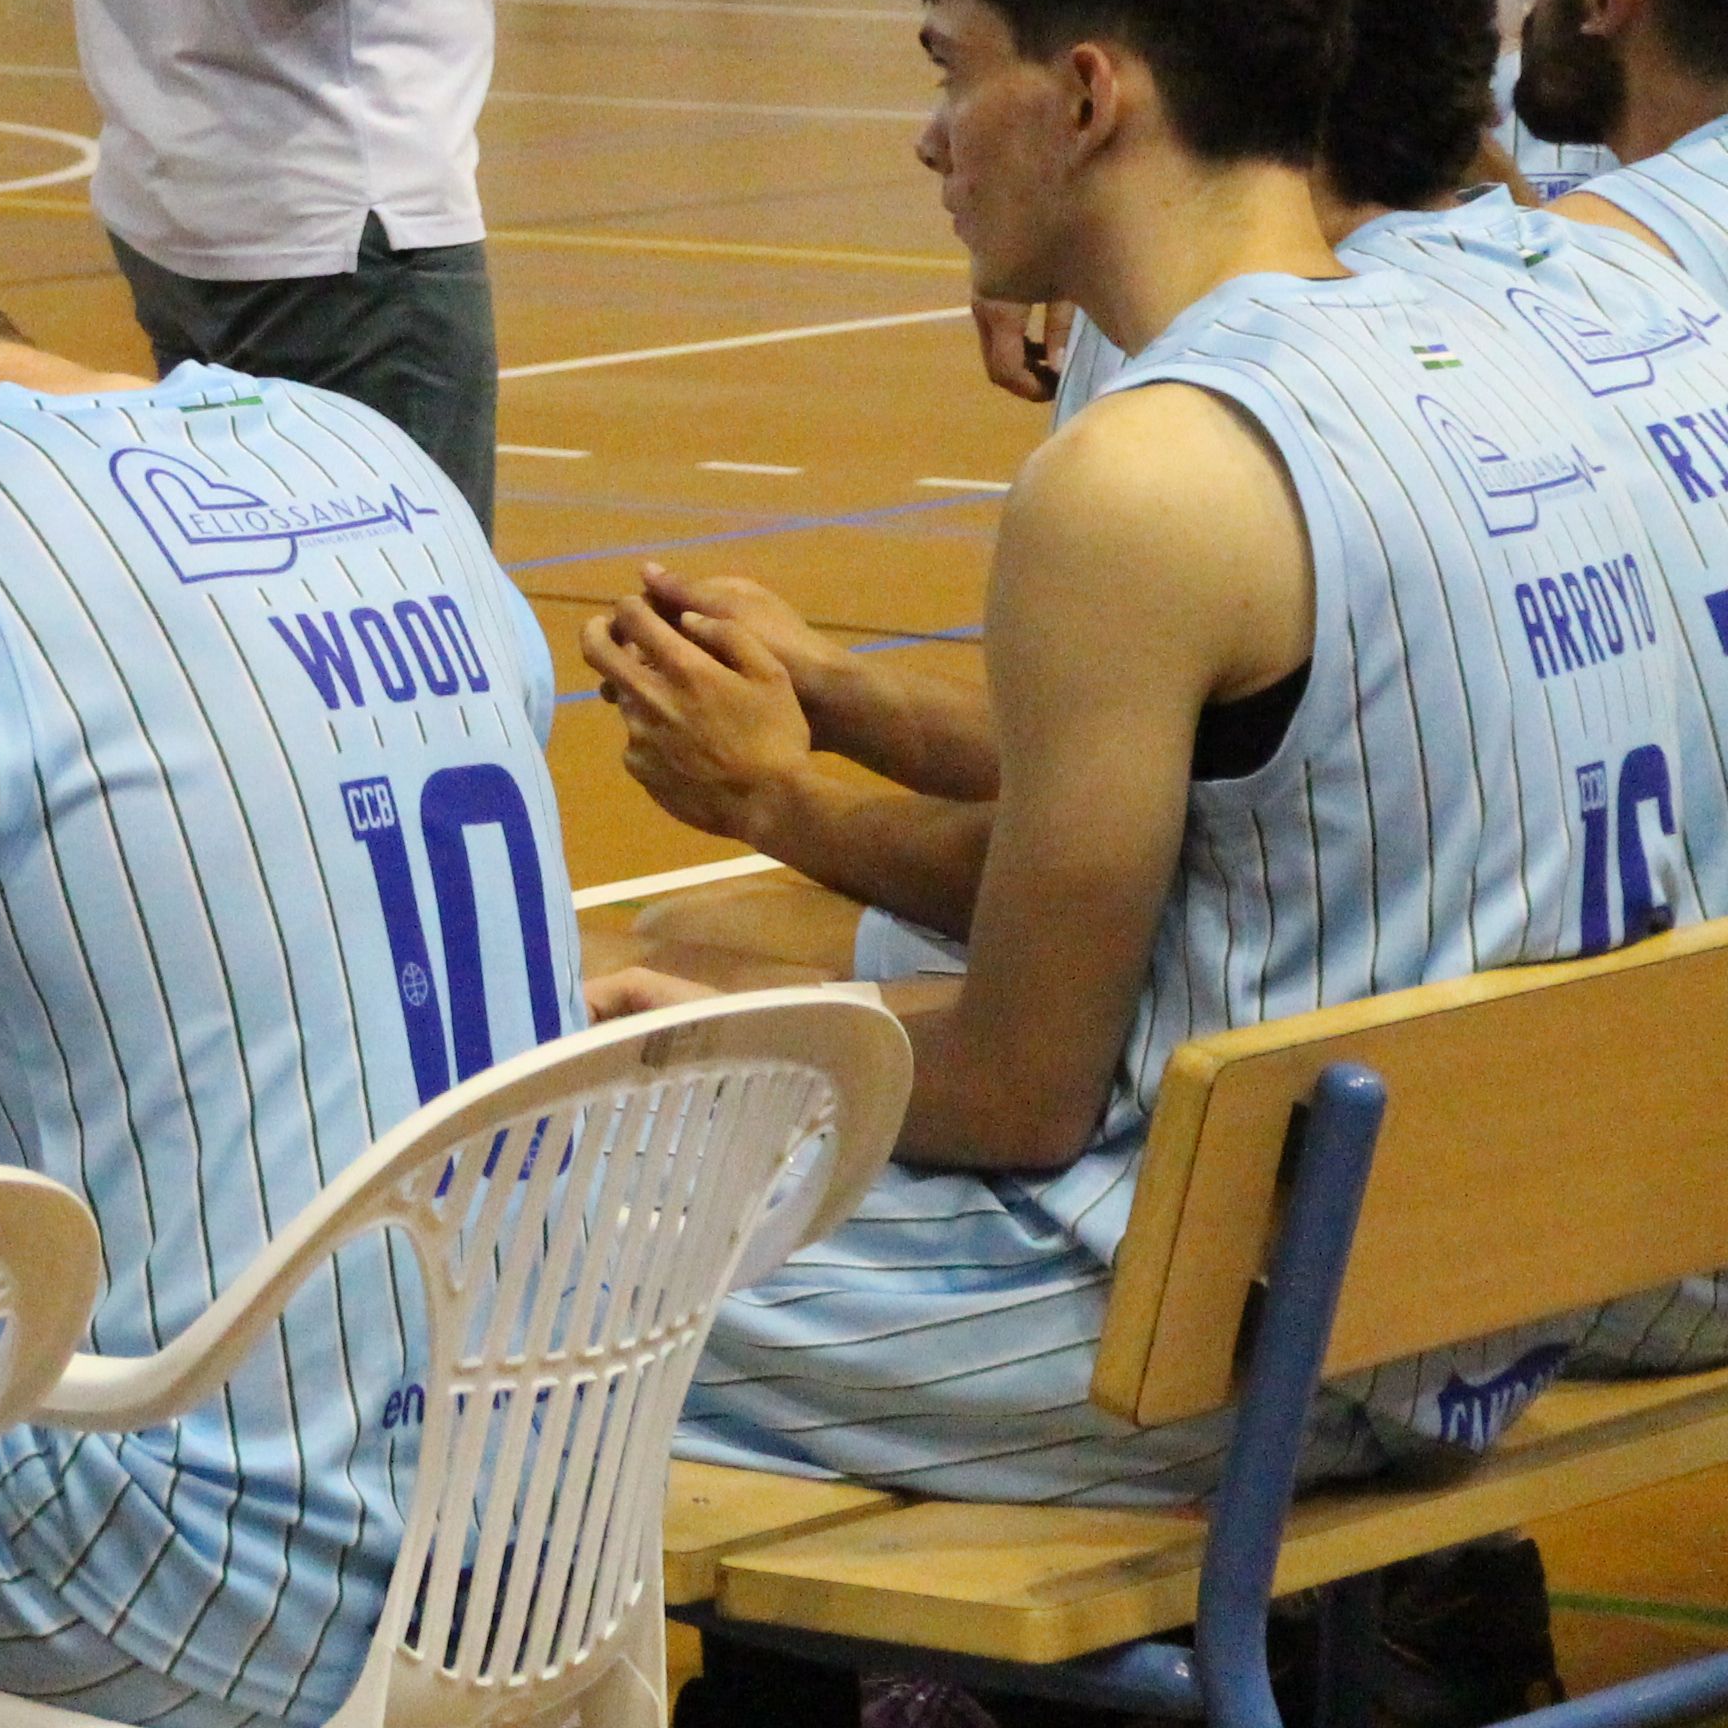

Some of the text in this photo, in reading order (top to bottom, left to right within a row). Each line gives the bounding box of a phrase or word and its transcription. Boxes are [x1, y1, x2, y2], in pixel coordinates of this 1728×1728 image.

[188, 494, 379, 537] ELIOSSANA
[268, 594, 491, 710] WOOD
[1514, 551, 1656, 680] ARROYO
[348, 787, 395, 832] CCB
[340, 762, 563, 1108] 10
